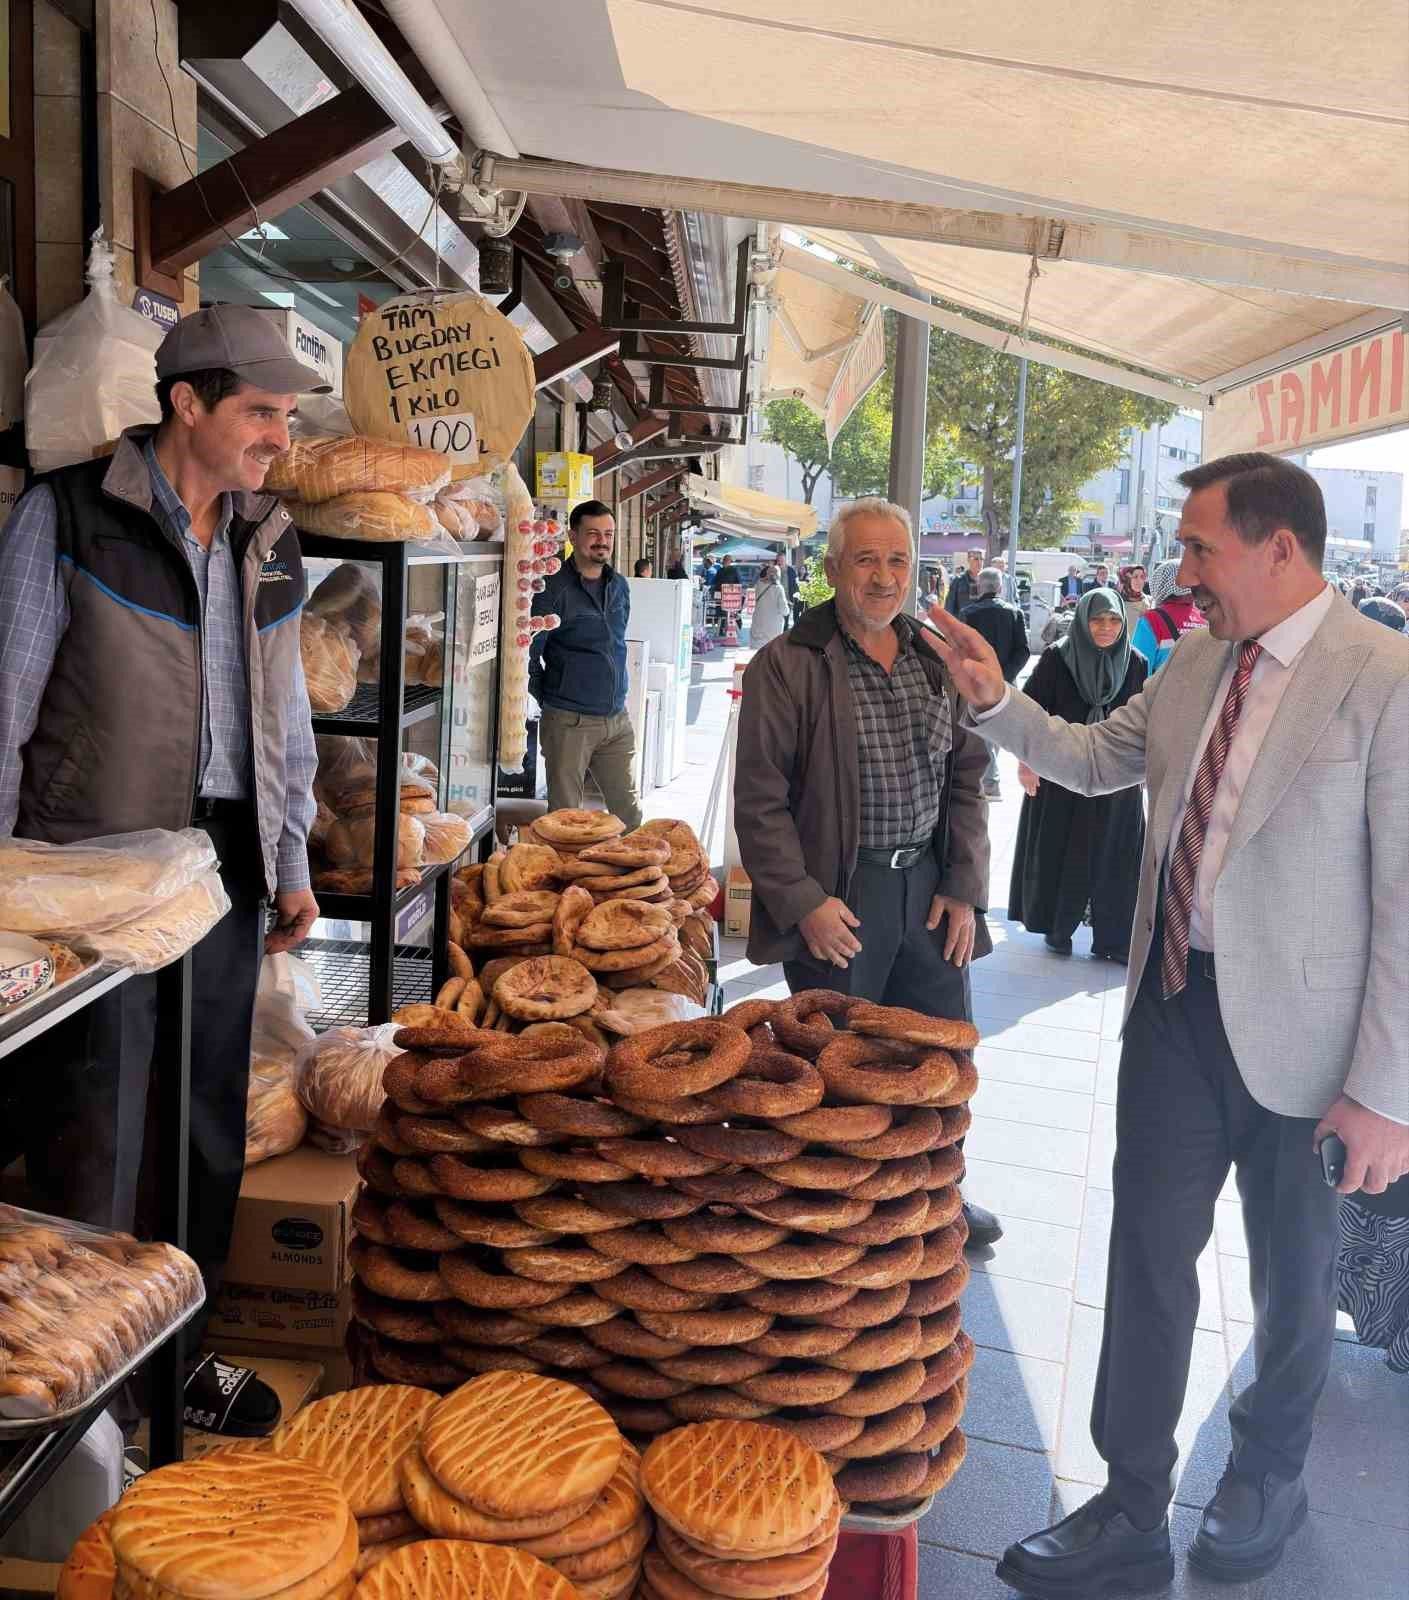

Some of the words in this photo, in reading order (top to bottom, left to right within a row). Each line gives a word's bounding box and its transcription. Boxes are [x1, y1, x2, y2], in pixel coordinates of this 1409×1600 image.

[382, 308, 435, 331] TAM
[372, 322, 471, 361] BUGDAY
[389, 396, 400, 423] 1
[413, 420, 472, 453] 100
[271, 1251, 322, 1264] ALMONDS
